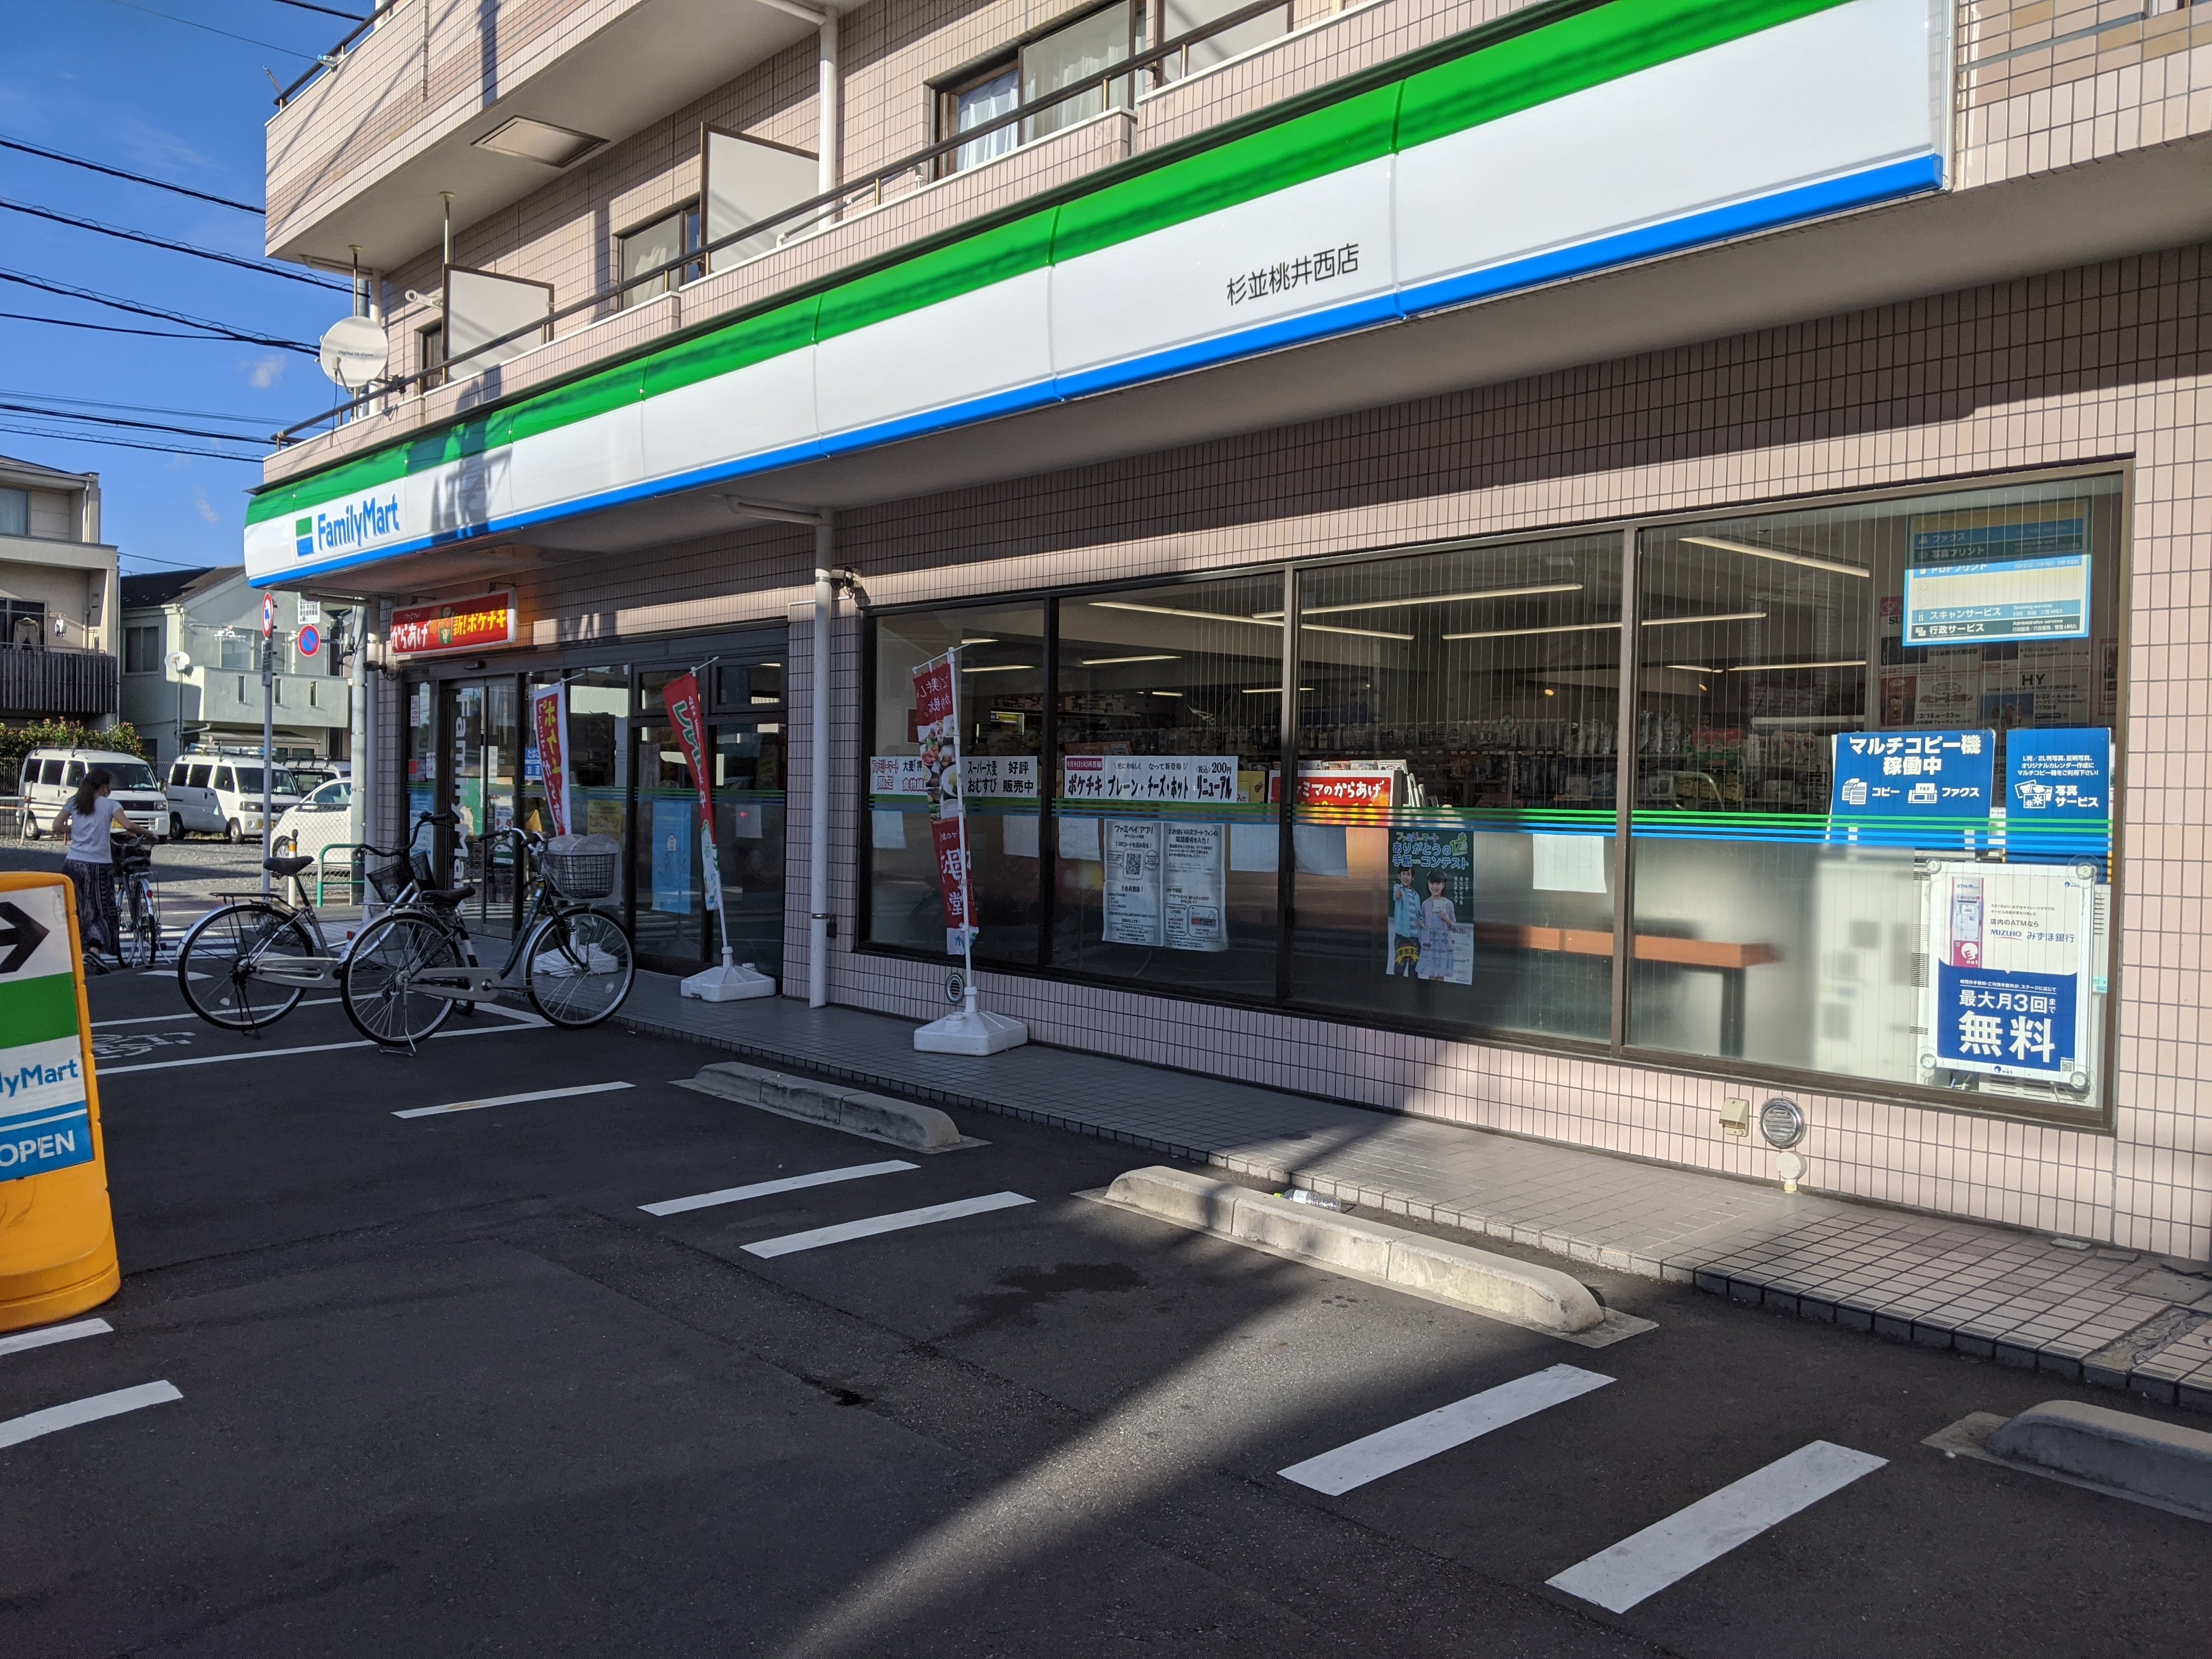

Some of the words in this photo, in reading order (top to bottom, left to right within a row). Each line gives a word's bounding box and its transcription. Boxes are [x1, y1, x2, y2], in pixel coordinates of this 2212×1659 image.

[1227, 243, 1359, 306] 杉並桃井西店
[318, 494, 399, 549] FamilyMart
[1929, 607, 2001, 620] スキャンサービス
[391, 620, 431, 651] からあげ
[1929, 623, 1985, 635] 行政サービス
[2022, 674, 2045, 686] HY
[1849, 735, 1982, 755] マルチコピー機
[872, 759, 899, 774] ファミリーマート
[902, 760, 924, 772] 大麦「押
[967, 760, 997, 776] スーパー大麦
[1008, 761, 1029, 775] 好評
[1883, 757, 1942, 776] 稼働中
[877, 775, 894, 791] 限定
[967, 778, 997, 794] おむすび
[1002, 779, 1034, 794] 販売中
[1068, 774, 1103, 797] ポケチキ
[1197, 775, 1232, 800] リニューアル
[1297, 780, 1385, 799] ミマのからあげ
[1871, 786, 1900, 797] コピー
[1942, 787, 1980, 798] ファクス
[2055, 785, 2078, 796] 写真
[2055, 797, 2099, 808] サービス
[1396, 832, 1440, 842] ファミリーマート
[1392, 841, 1452, 856] ありがとうの
[1392, 854, 1413, 868] 手紙
[1420, 856, 1470, 871] コンテスト
[1990, 918, 2039, 927] 店内のATMなら
[1990, 929, 2022, 938] MIZUHO
[2027, 931, 2075, 943] みずほ銀行
[1959, 1010, 2056, 1063] 無料
[0, 1129, 76, 1167] OPEN
